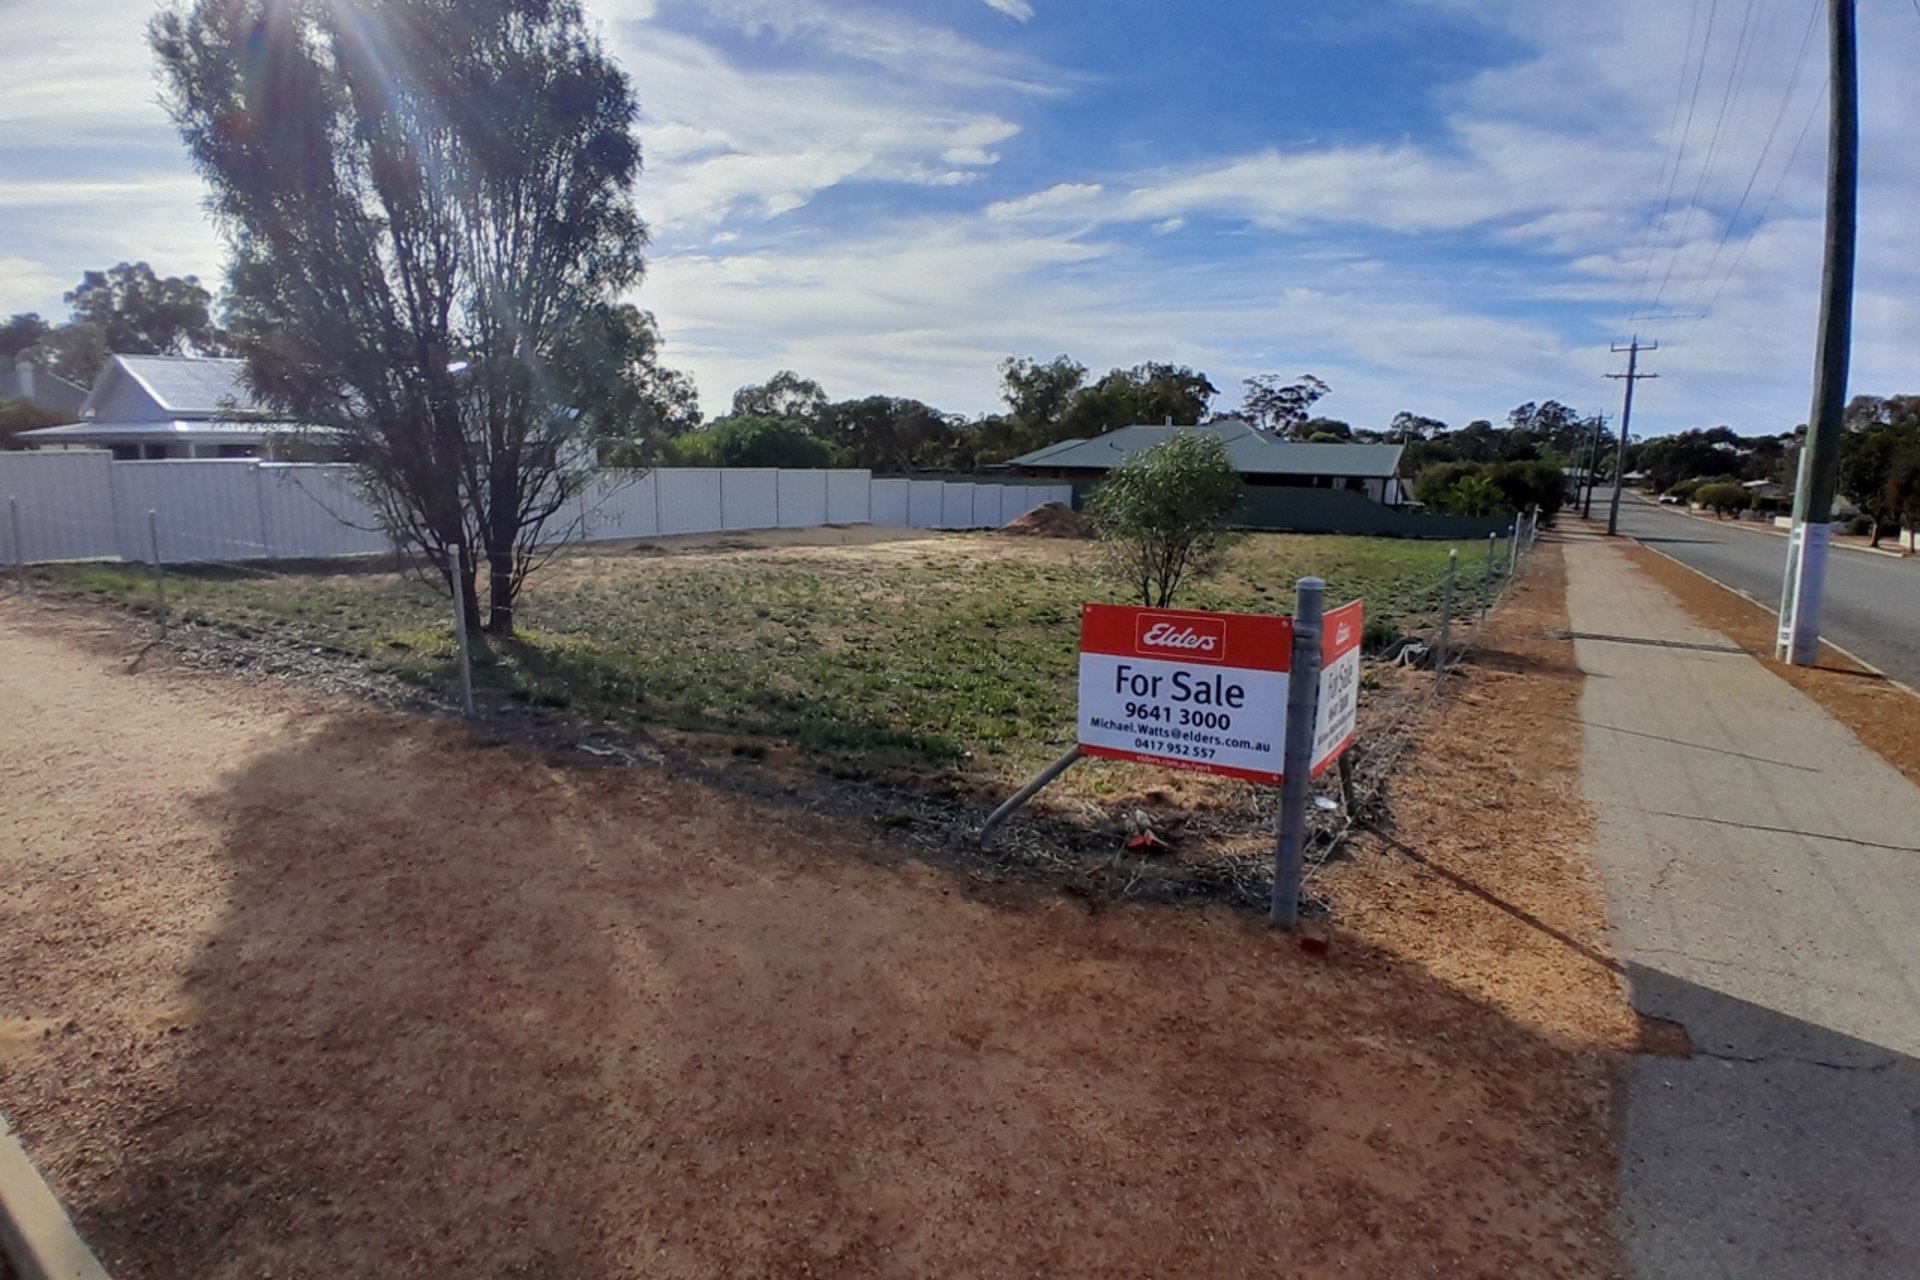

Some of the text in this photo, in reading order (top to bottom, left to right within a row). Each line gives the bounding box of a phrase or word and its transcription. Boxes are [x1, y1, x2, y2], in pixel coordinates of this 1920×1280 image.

[1143, 622, 1218, 651] Elders
[1115, 664, 1245, 709] For Sale
[1125, 702, 1231, 731] 9641 3000
[1090, 717, 1271, 752] Michael.Watts@elders.com.au
[1134, 738, 1216, 759] 0417 952 557
